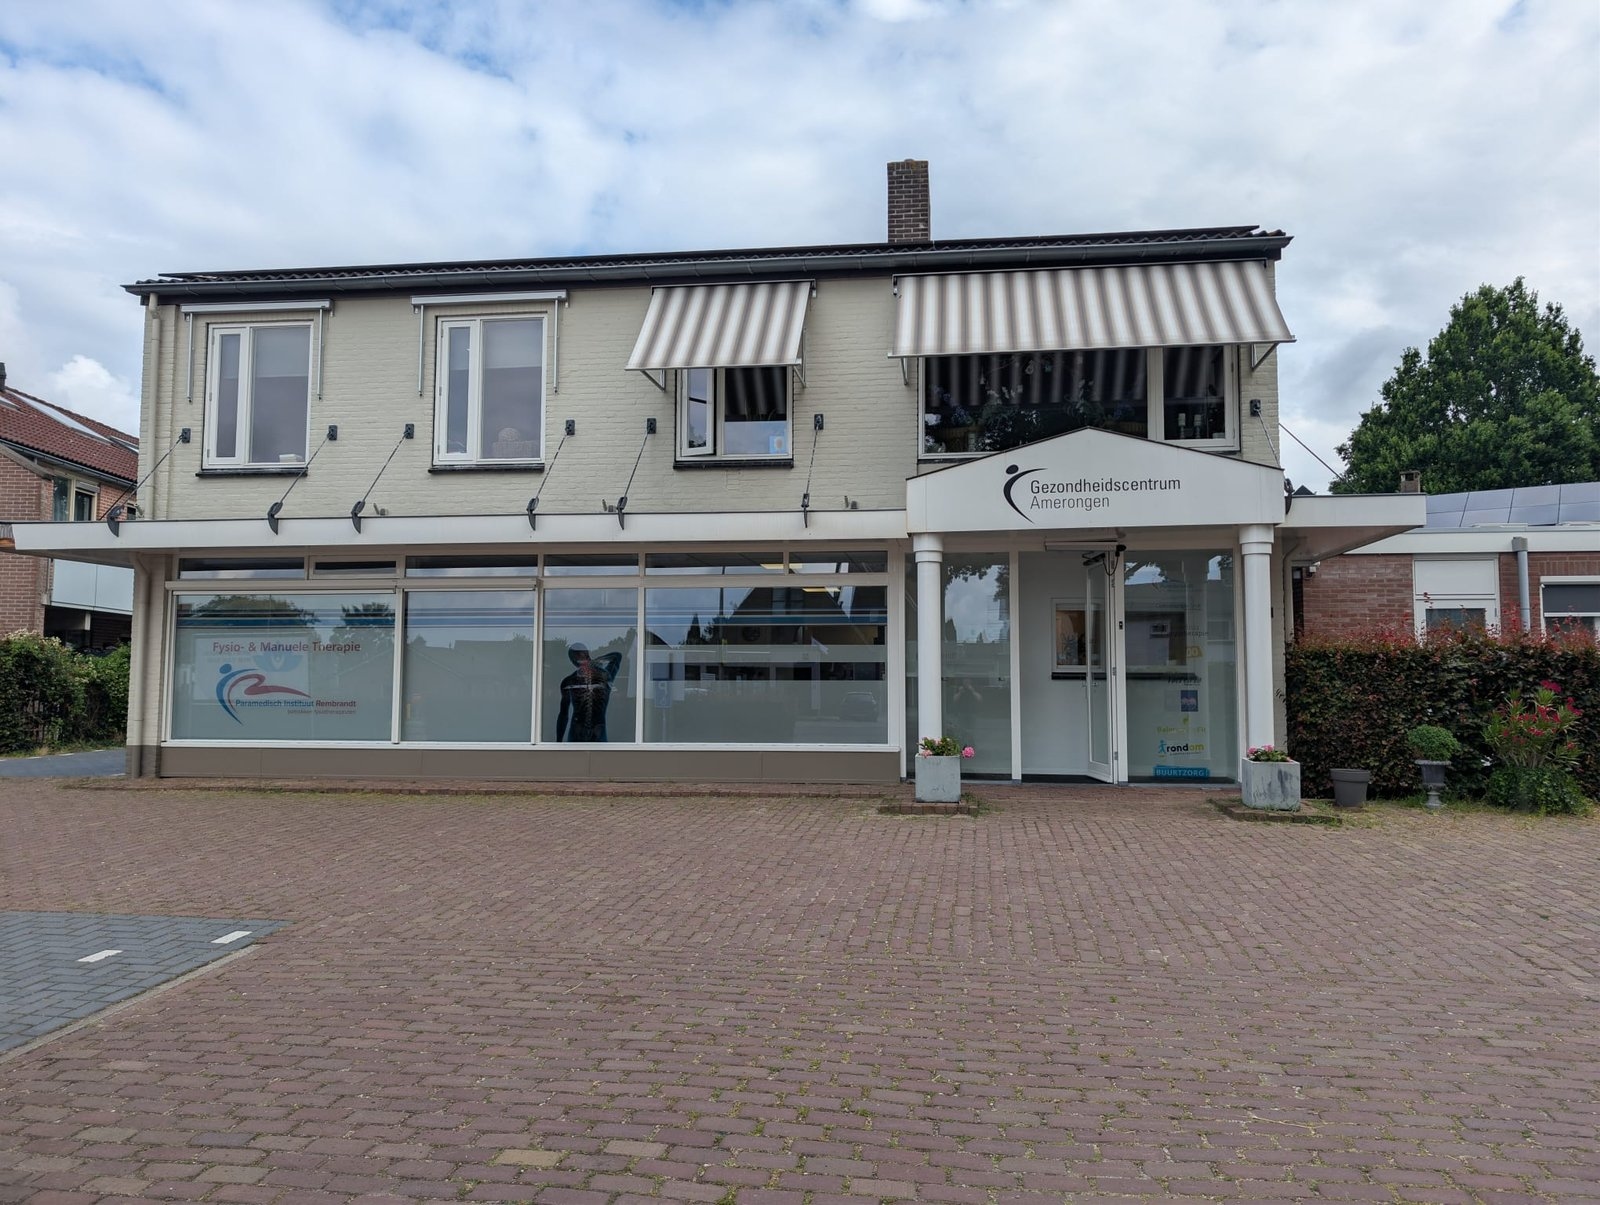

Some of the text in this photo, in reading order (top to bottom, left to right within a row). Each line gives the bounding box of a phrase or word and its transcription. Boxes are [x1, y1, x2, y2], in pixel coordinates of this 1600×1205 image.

[1030, 478, 1181, 494] Gezondheidscentrum
[1030, 495, 1110, 511] Amerongen
[212, 641, 361, 654] Fysio- & Manuele Therapie
[235, 699, 357, 707] Paramedisch Instituut Rembrandt
